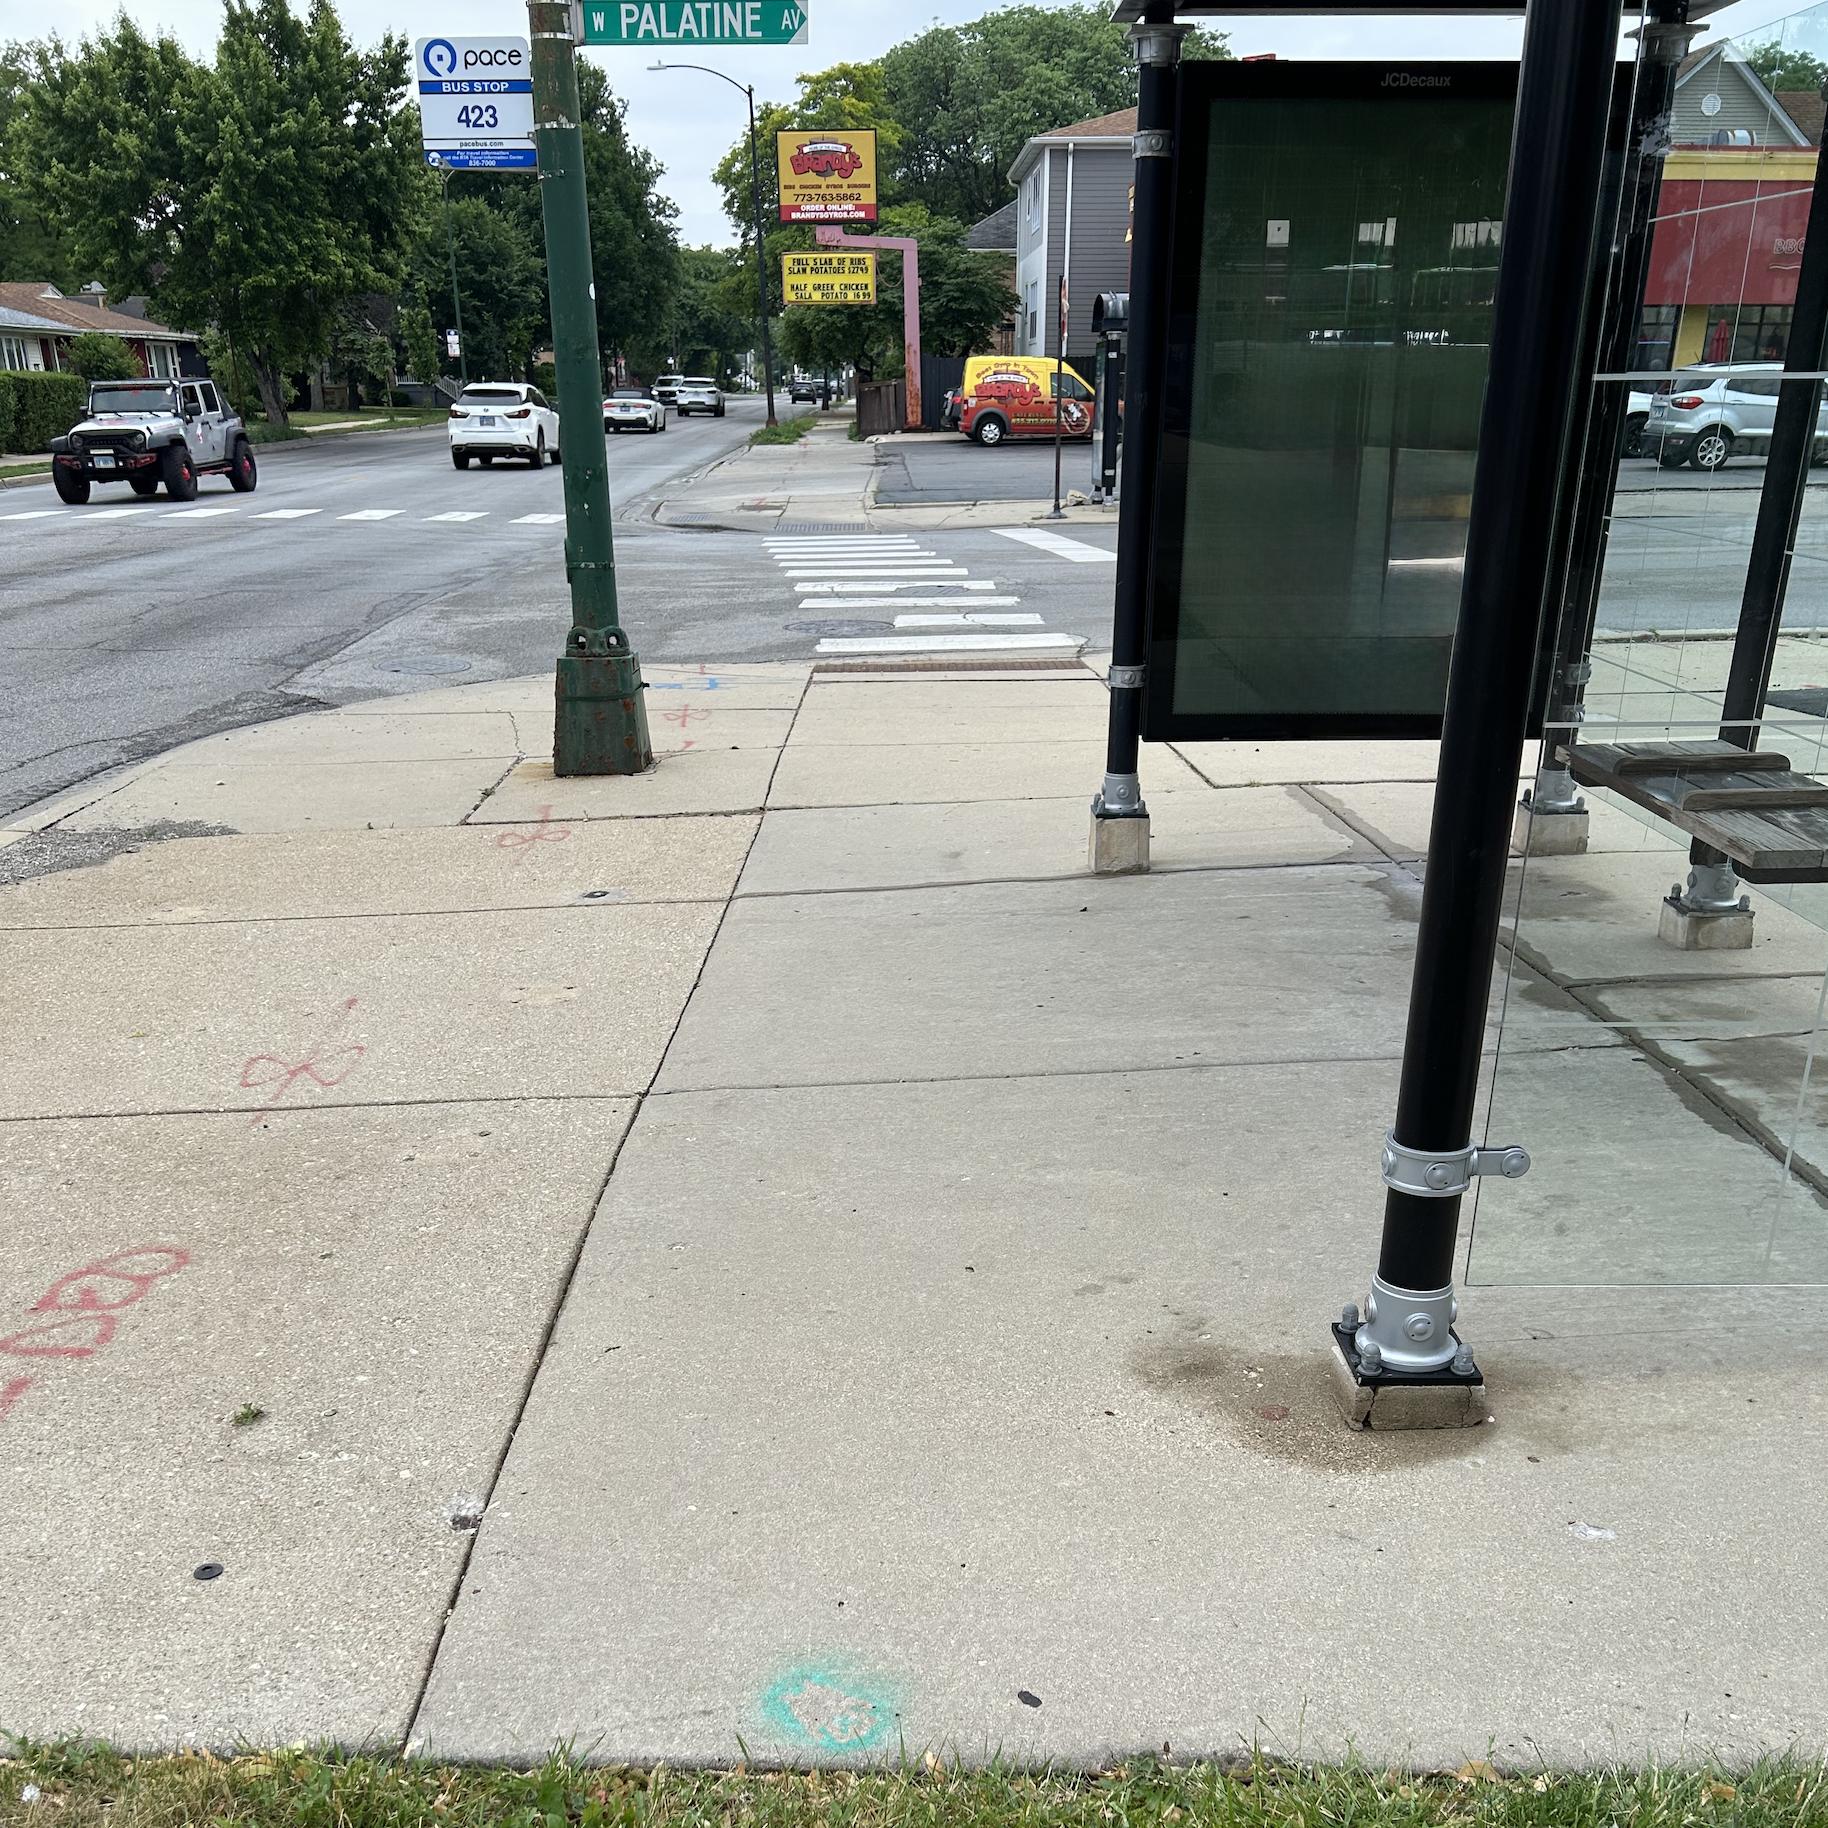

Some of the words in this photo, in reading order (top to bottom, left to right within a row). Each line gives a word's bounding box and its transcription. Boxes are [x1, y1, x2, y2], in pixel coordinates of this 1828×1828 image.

[592, 12, 605, 32] W
[620, 2, 762, 39] PALATINE
[781, 9, 801, 30] AV
[464, 49, 522, 70] pace
[1380, 72, 1452, 87] JCDecaux
[442, 82, 470, 93] BUS
[473, 81, 509, 92] STOP
[457, 104, 499, 128] 423
[459, 140, 504, 148] pacebus.com
[793, 192, 862, 202] 773-763-5862
[800, 204, 825, 212] ORDER
[826, 203, 856, 211] ONLINE:
[791, 211, 866, 219] BRANDYSGYROS.COM
[792, 258, 810, 266] FULL
[837, 258, 846, 266] OF
[849, 257, 866, 266] RIBS
[810, 266, 845, 275] POTATOES
[790, 283, 808, 292] HALF
[812, 283, 835, 291] GREEK
[839, 283, 869, 291] CHICKEN
[821, 291, 848, 300] POTATO
